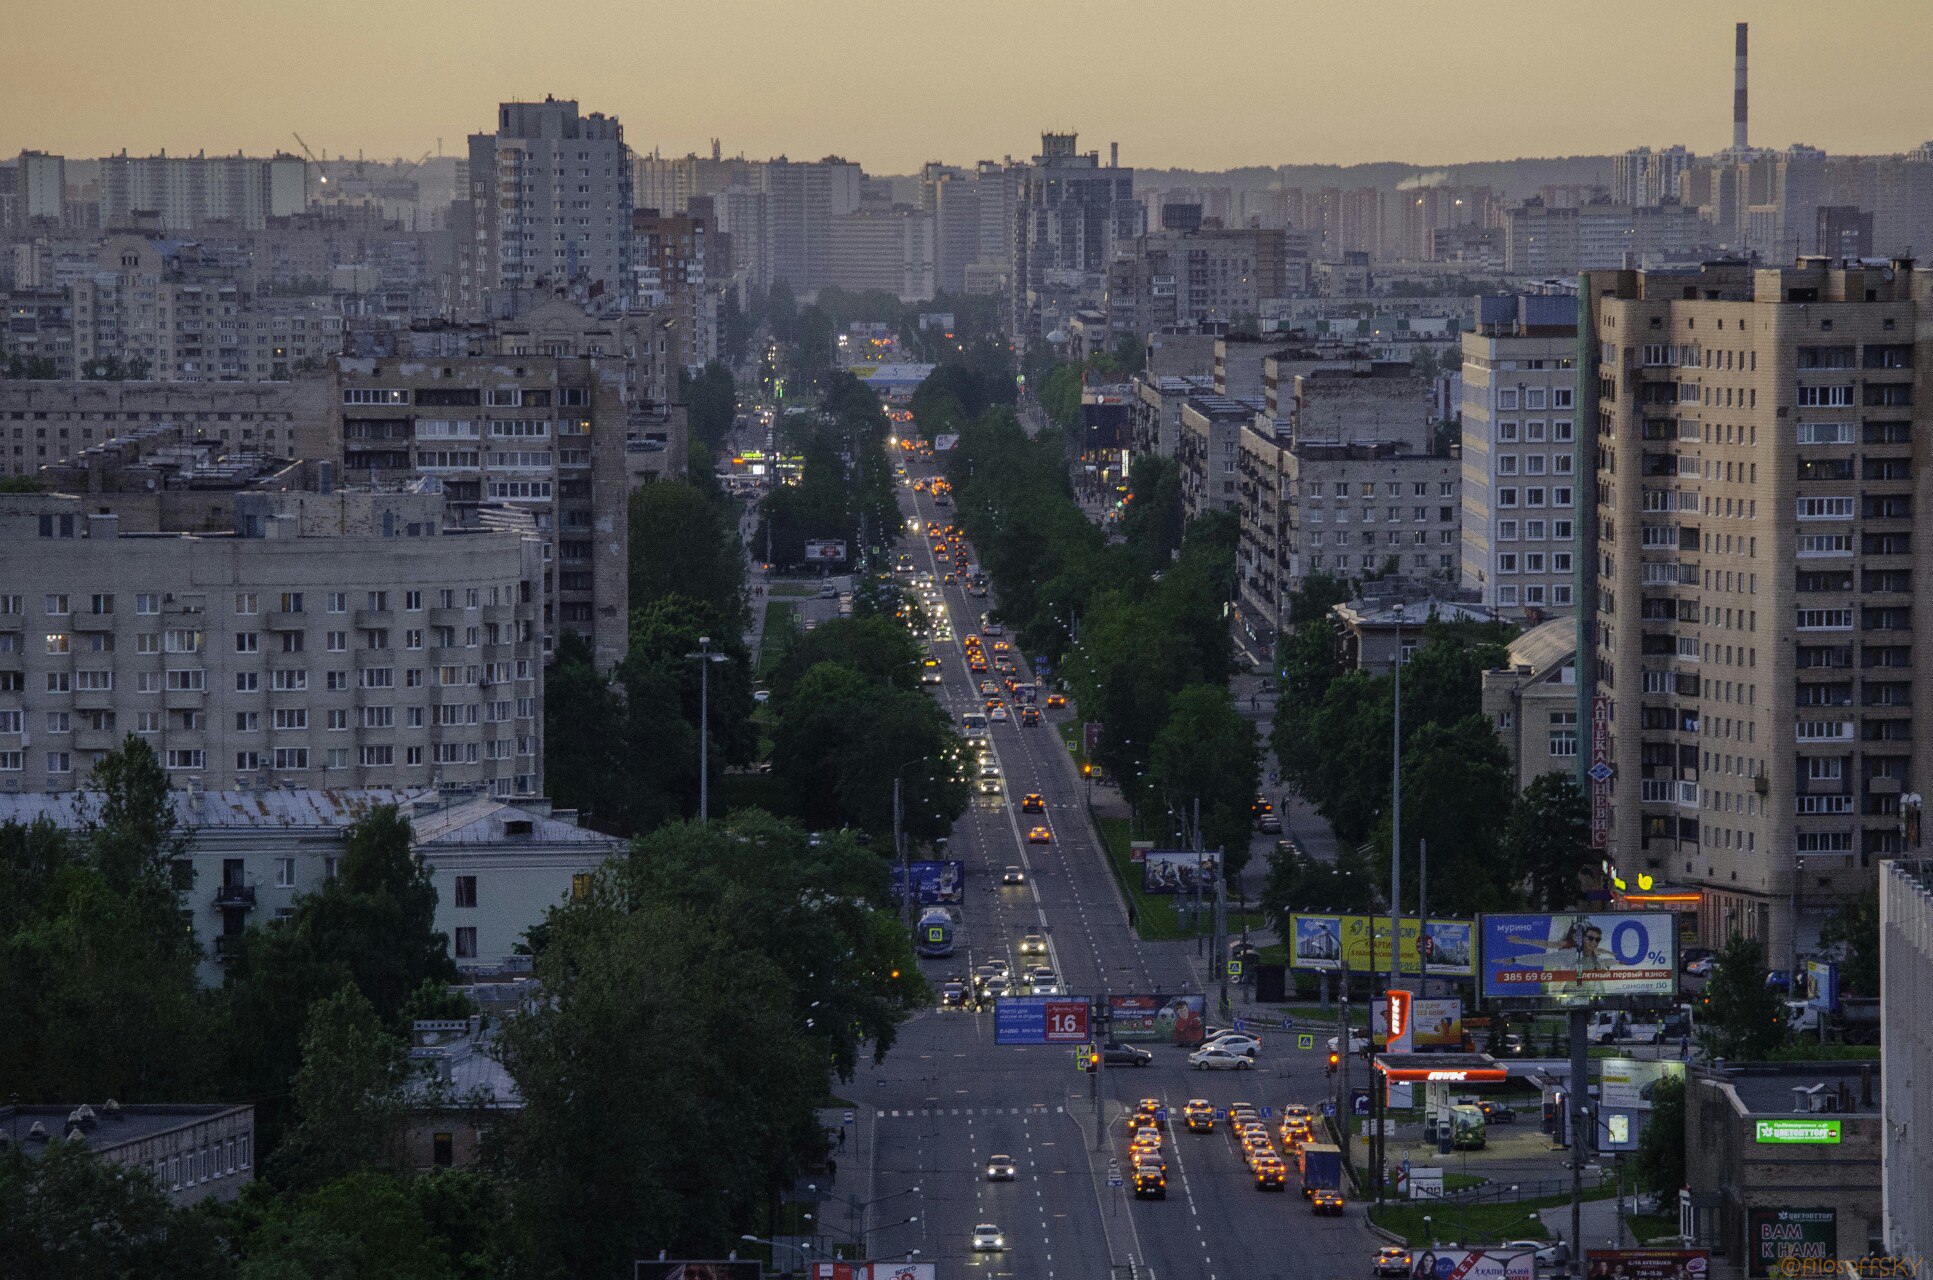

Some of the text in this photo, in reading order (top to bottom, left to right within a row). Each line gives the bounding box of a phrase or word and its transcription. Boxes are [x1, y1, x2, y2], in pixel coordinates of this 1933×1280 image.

[1595, 699, 1606, 760] АПТЕКА
[1595, 784, 1606, 843] НЕВИС
[1497, 922, 1532, 933] мурино
[1503, 972, 1553, 981] 385 69 69
[1613, 969, 1643, 980] первый
[1645, 970, 1667, 978] взнос
[1761, 1223, 1803, 1240] ВАМ
[1761, 1242, 1826, 1259] К НАМ!
[1481, 1266, 1530, 1276] КАПИОЛИЙ
